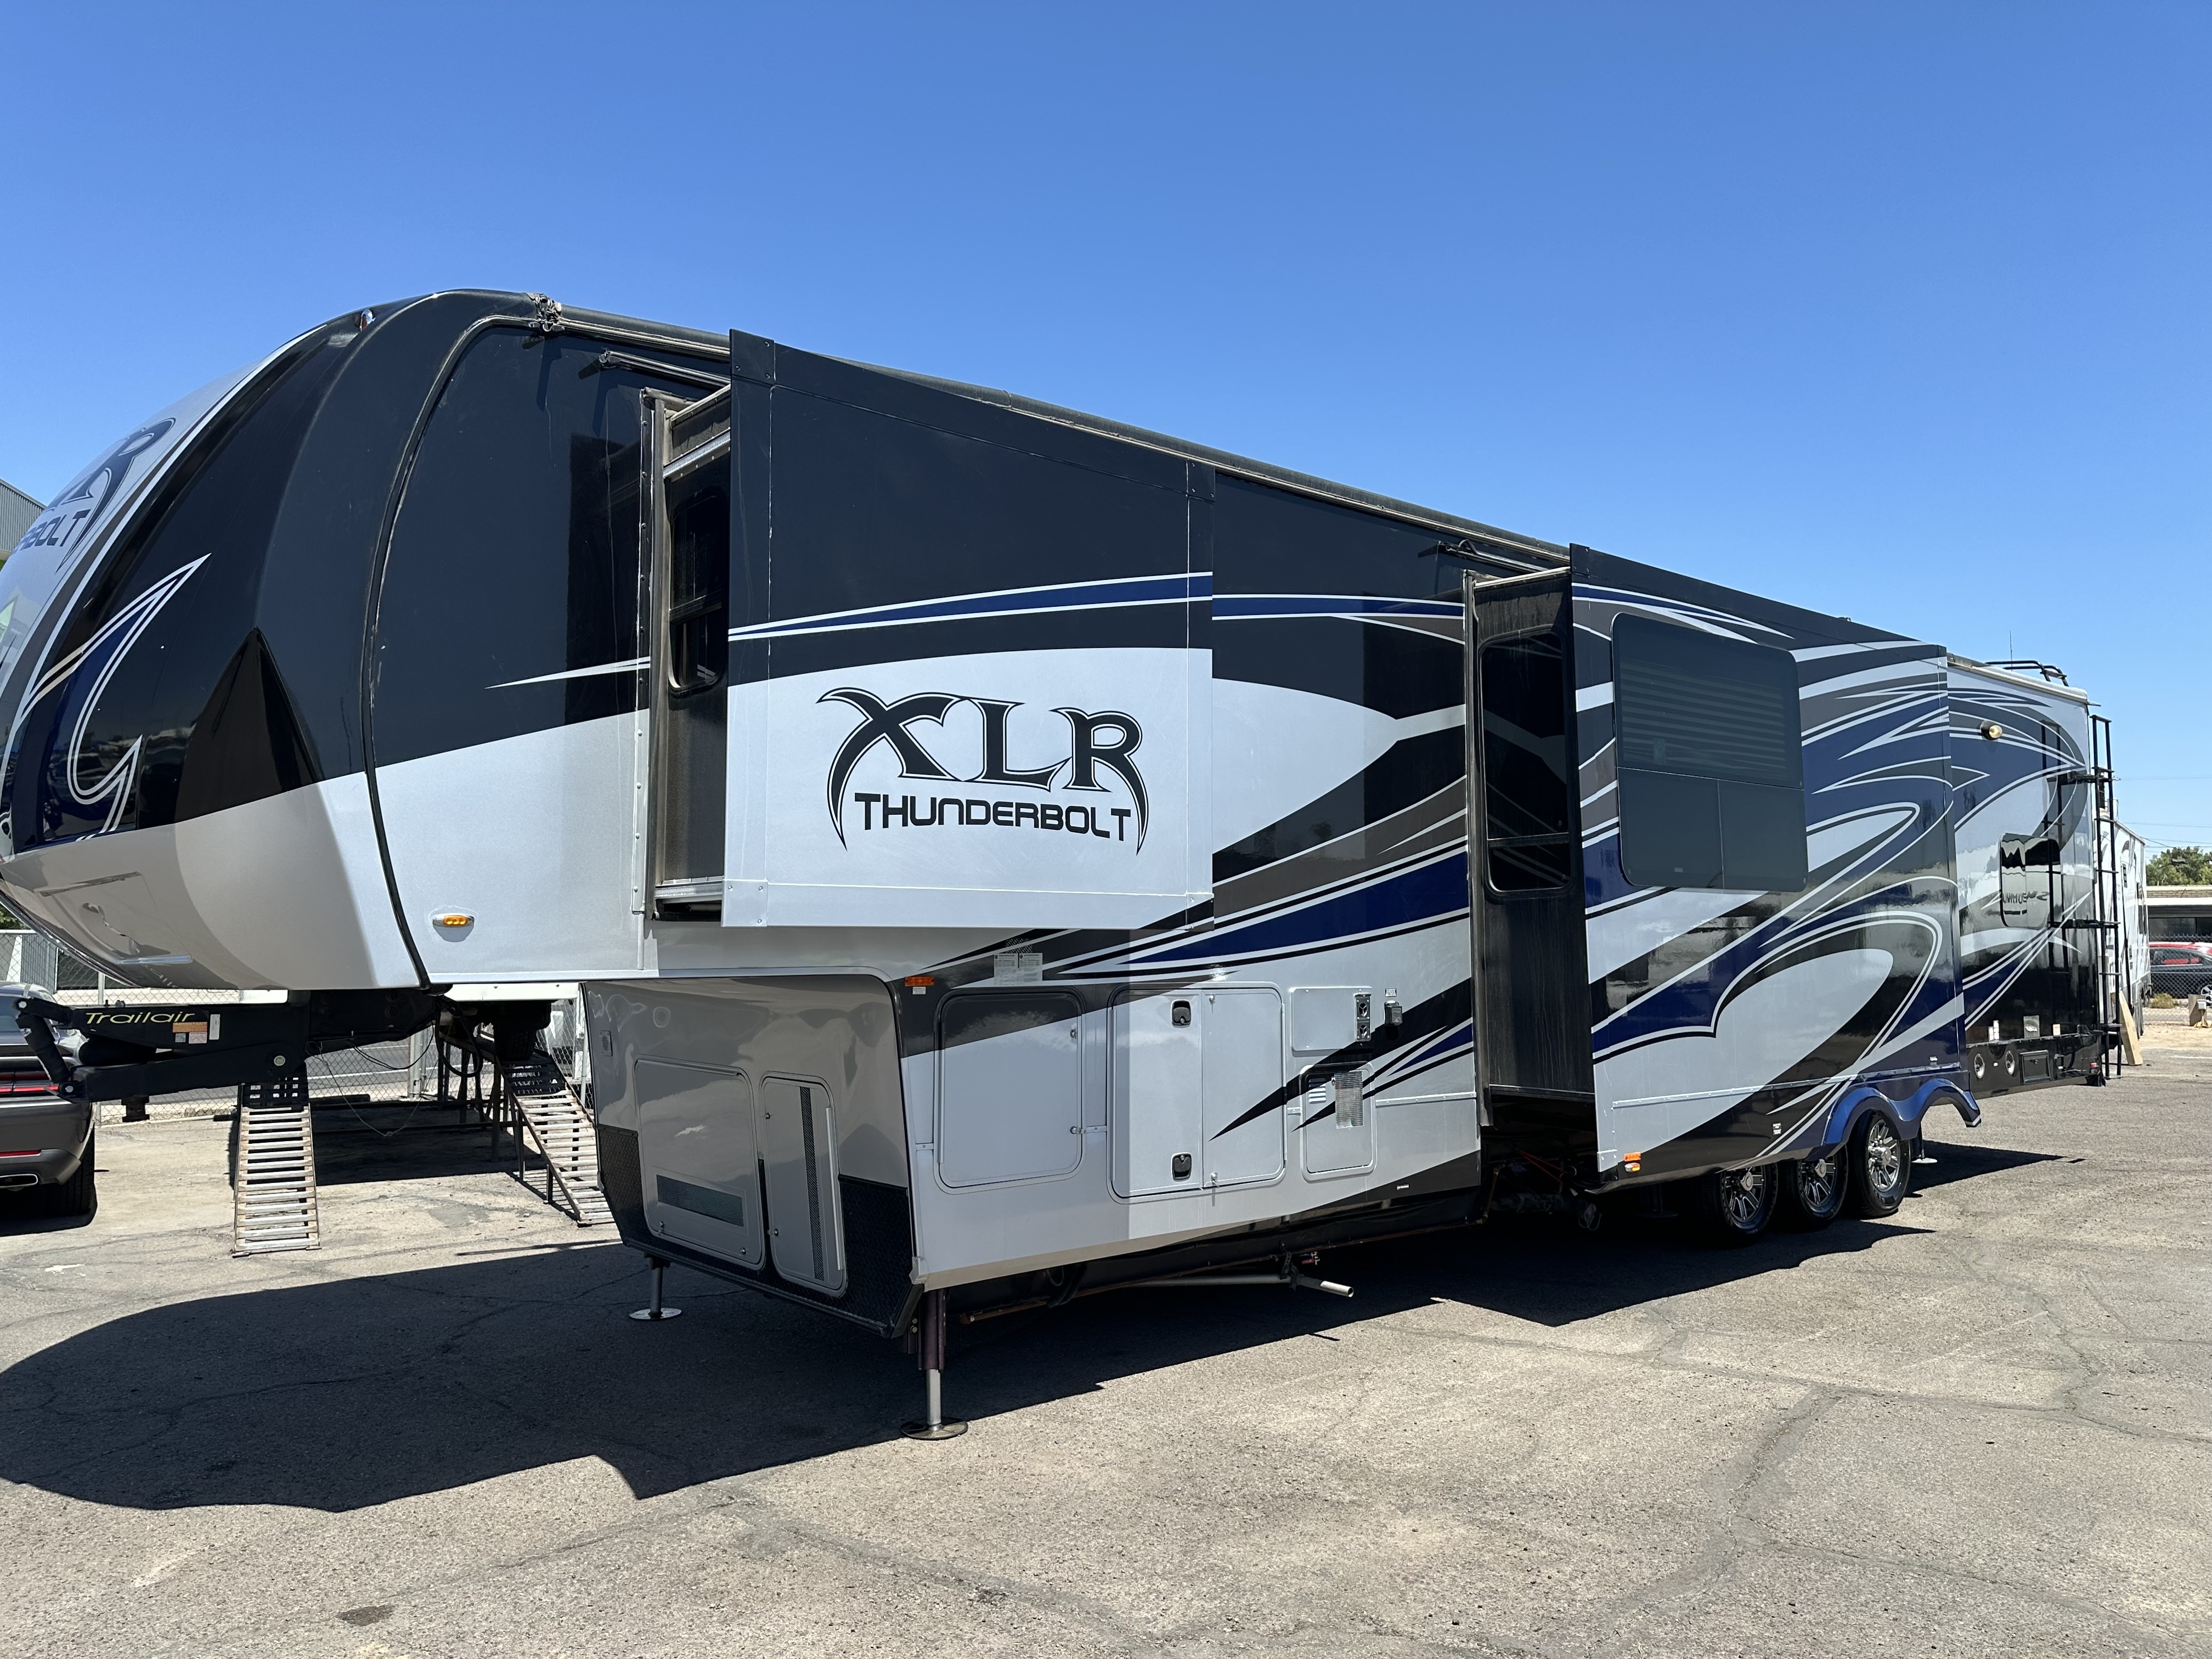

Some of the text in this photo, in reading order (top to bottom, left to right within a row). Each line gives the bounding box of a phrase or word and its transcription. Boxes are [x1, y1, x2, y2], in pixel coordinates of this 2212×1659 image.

[815, 687, 1149, 855] XLR
[854, 792, 1131, 841] THUNDERBOLT
[86, 1011, 195, 1024] Trailair
